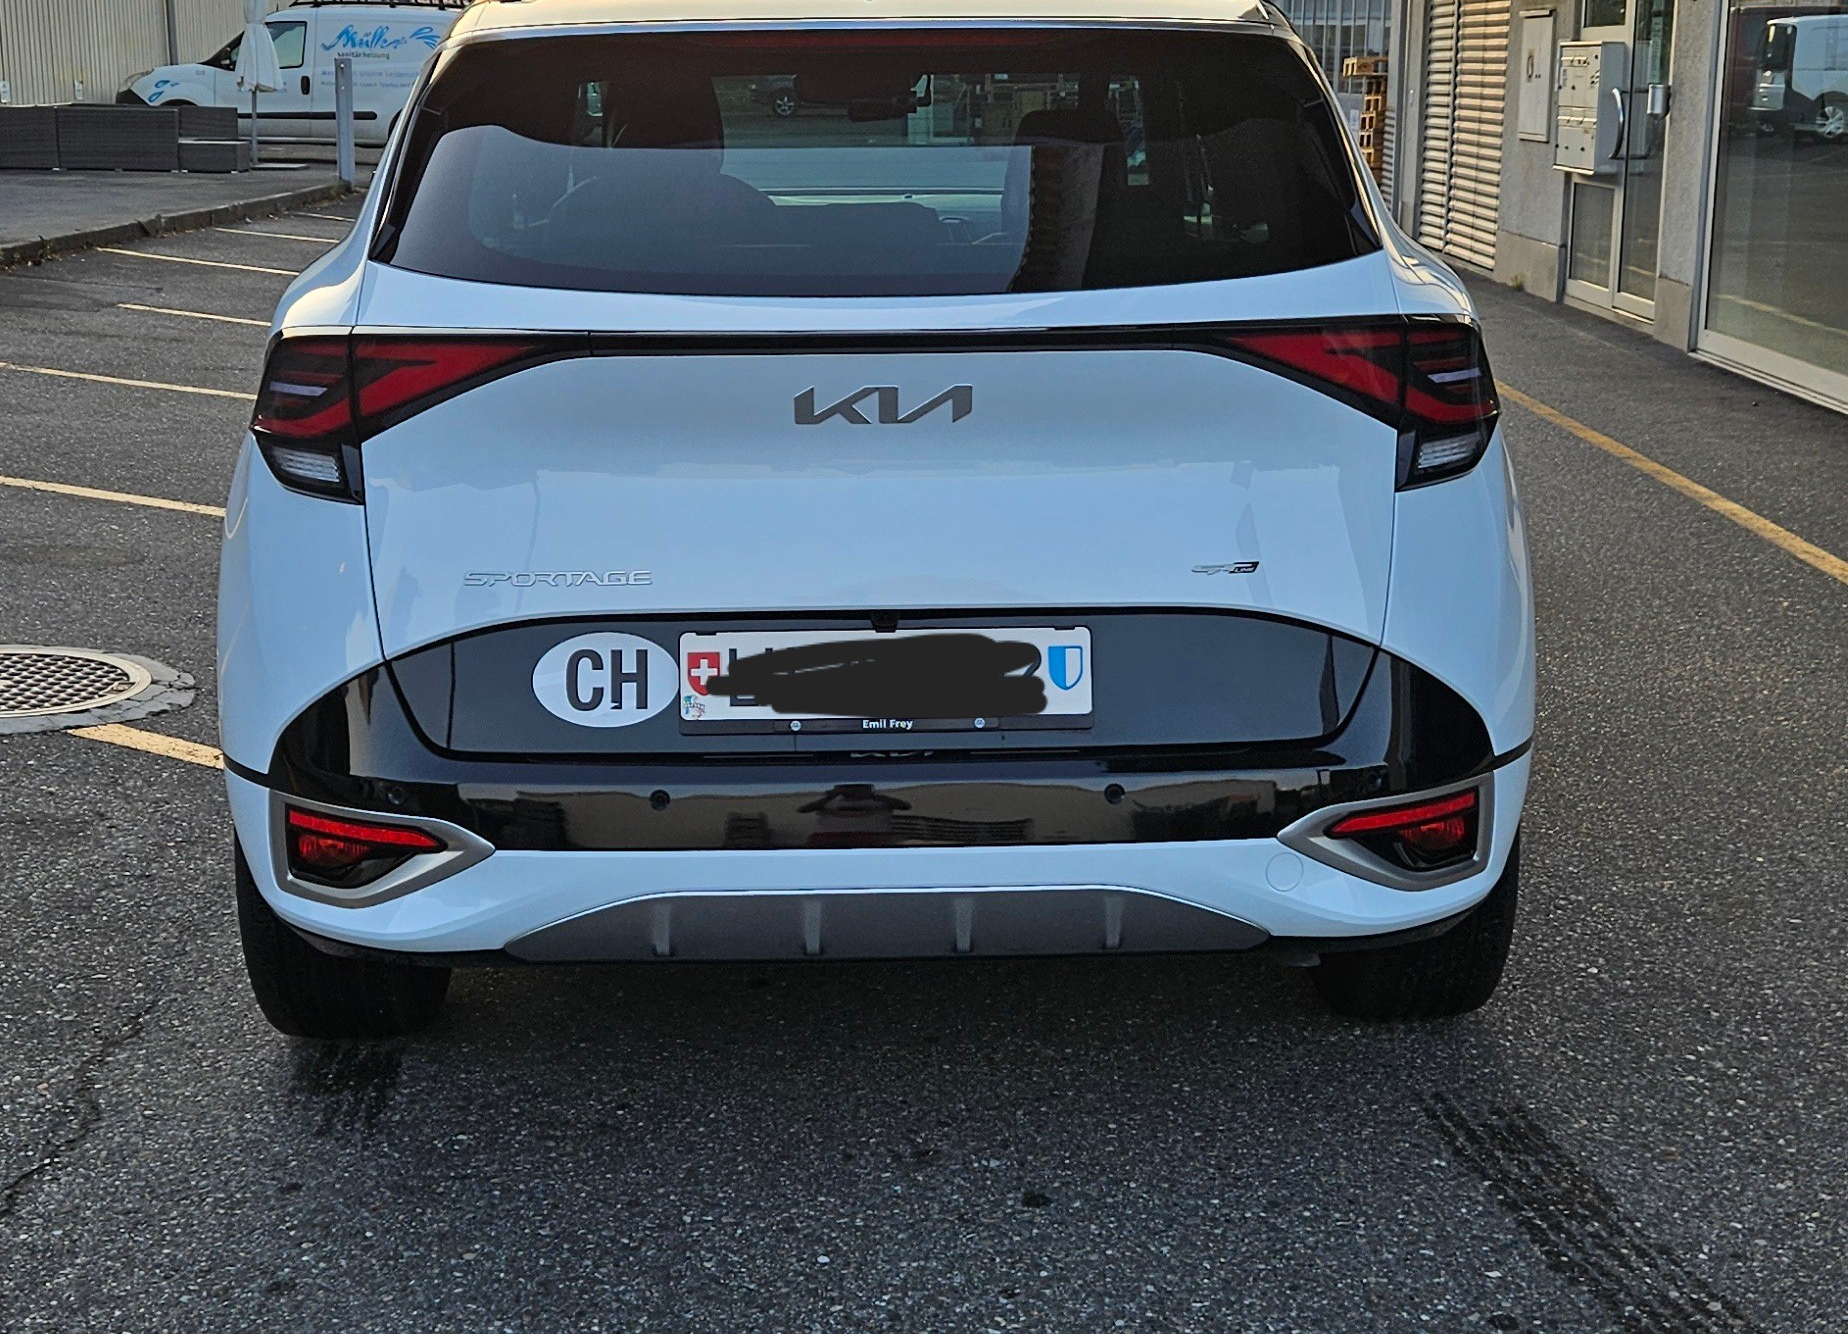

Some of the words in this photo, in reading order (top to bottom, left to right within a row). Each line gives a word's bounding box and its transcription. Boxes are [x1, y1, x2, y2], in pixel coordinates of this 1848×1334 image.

[321, 24, 400, 51] Müller
[794, 384, 973, 424] KIA
[463, 570, 652, 587] SPORTAGE
[566, 648, 649, 711] CH
[862, 719, 887, 729] Emil
[889, 719, 914, 730] Frey
